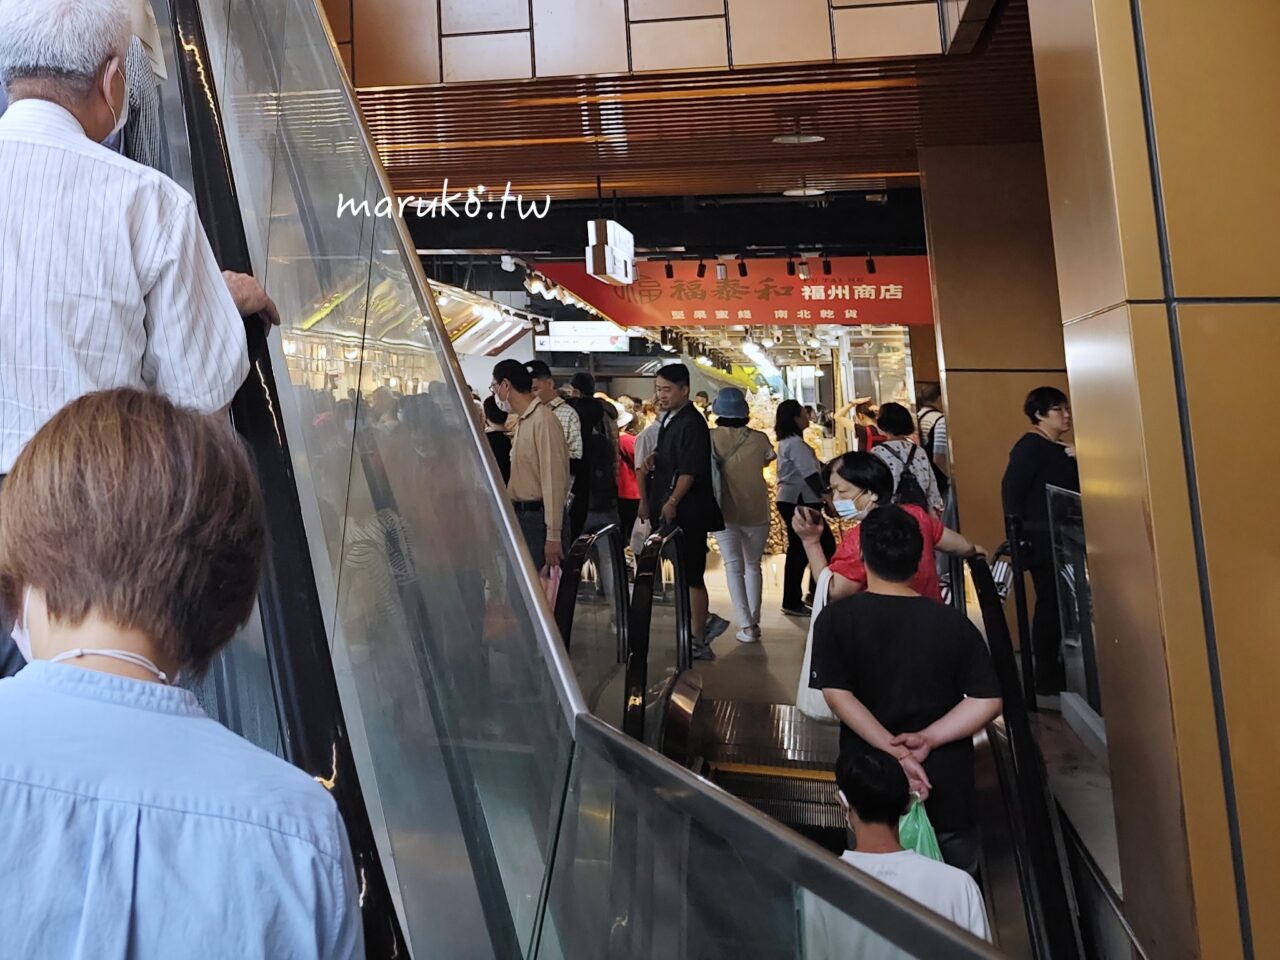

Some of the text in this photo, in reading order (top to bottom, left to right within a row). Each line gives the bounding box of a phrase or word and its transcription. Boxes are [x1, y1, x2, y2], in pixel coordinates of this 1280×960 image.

[669, 276, 794, 301] 福泰和
[801, 284, 904, 301] 福州商店
